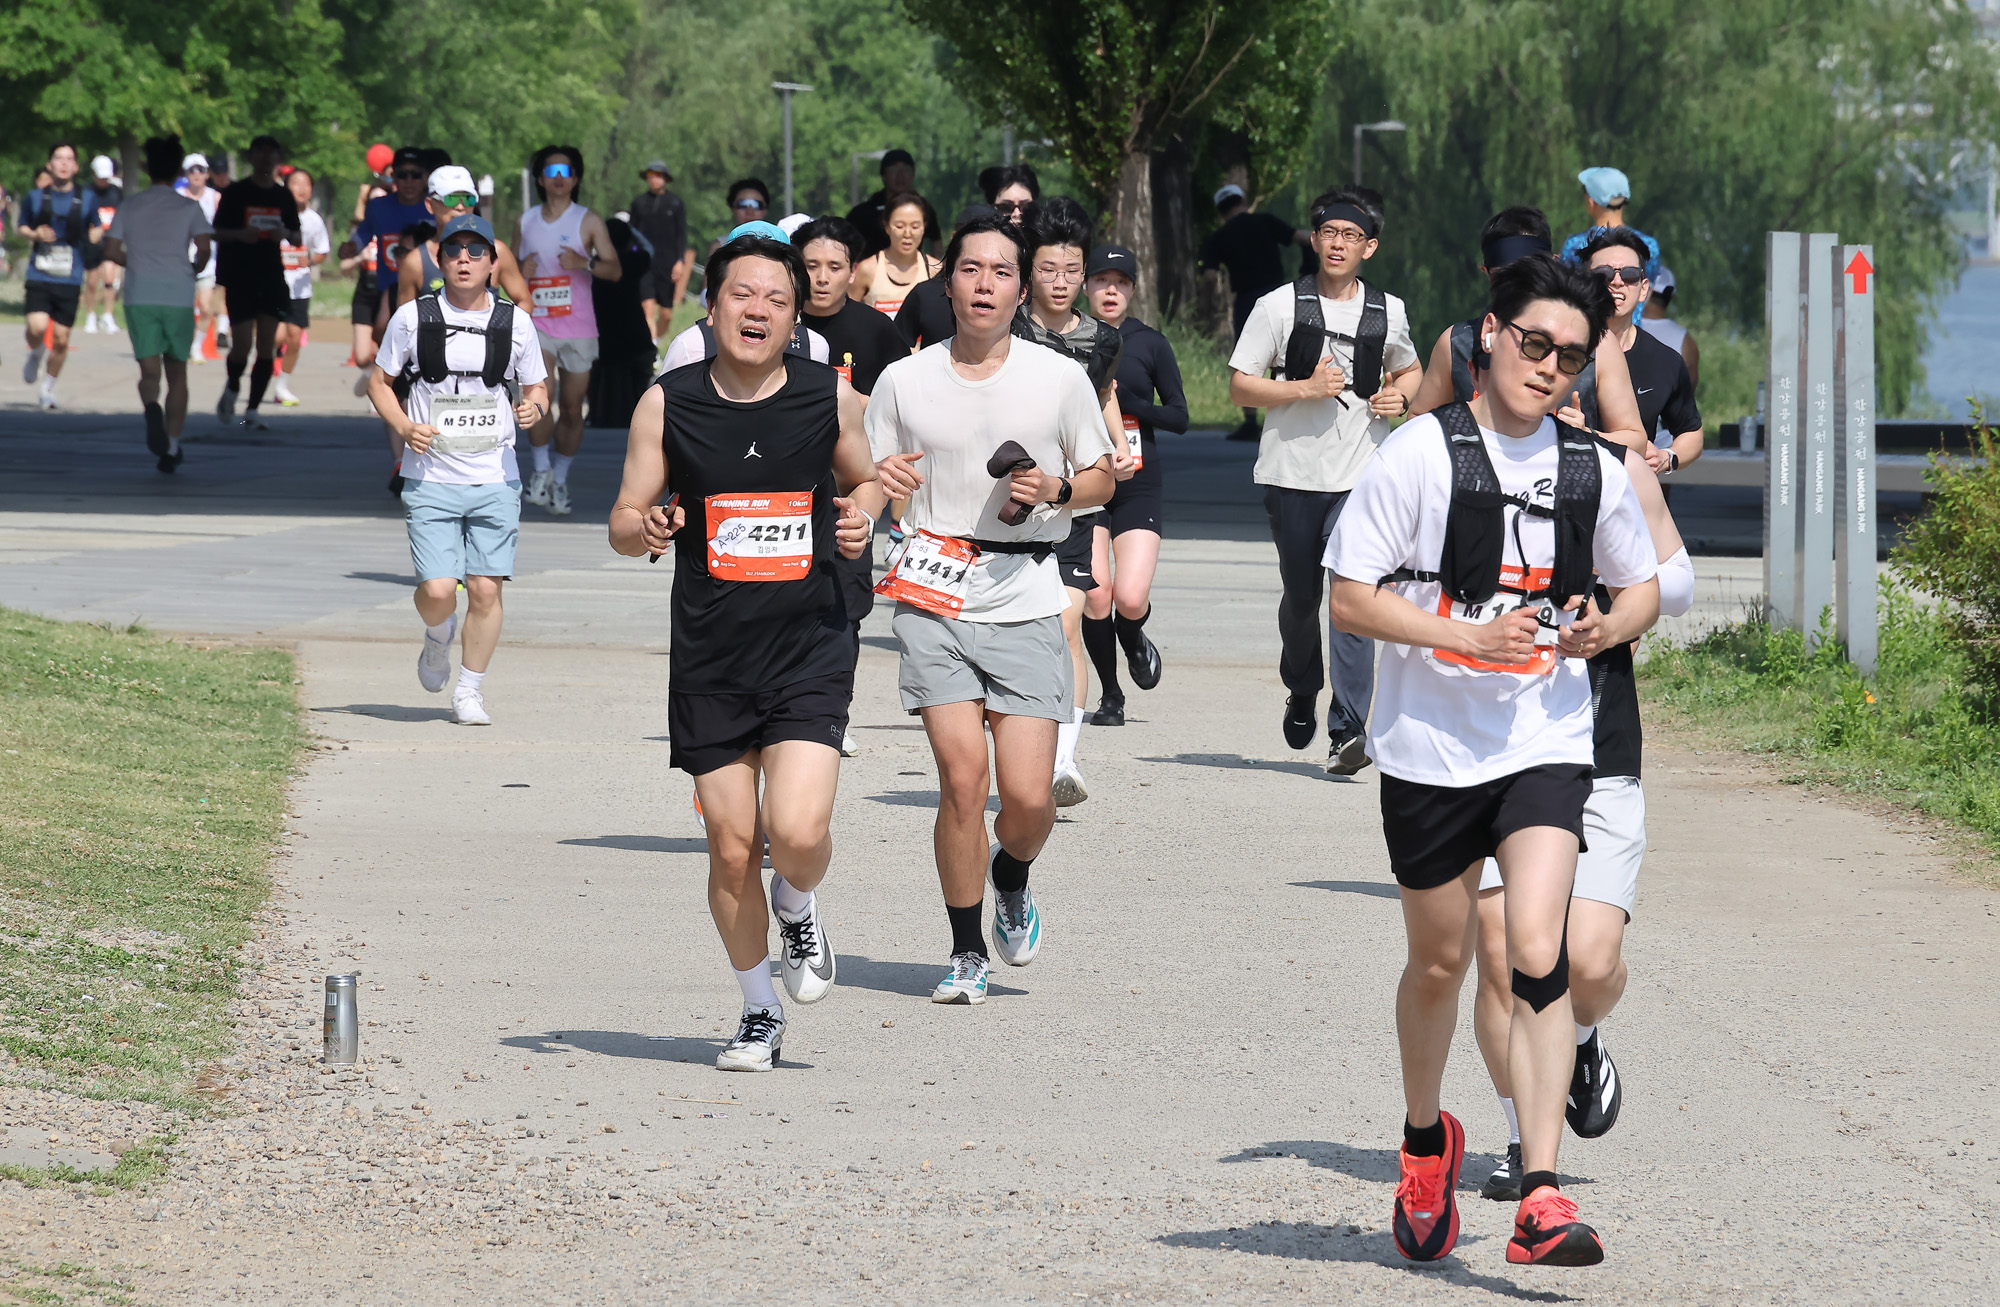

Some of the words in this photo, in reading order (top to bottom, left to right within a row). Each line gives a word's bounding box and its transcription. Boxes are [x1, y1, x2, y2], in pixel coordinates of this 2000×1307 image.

[444, 417, 454, 426] M
[458, 414, 496, 427] 5133
[1780, 443, 1789, 485] HANGANG
[1815, 450, 1824, 493] HANGANG
[1780, 486, 1789, 506] PARK
[1857, 467, 1866, 512] HANGANG
[711, 499, 750, 508] BURNING
[751, 499, 770, 508] RUN
[1815, 494, 1824, 514] PARK
[748, 523, 807, 541] 4211
[1857, 513, 1867, 534] PARK
[718, 523, 747, 549] A-225
[917, 558, 967, 583] 1411
[1498, 571, 1523, 583] RUN
[1463, 604, 1483, 619] M
